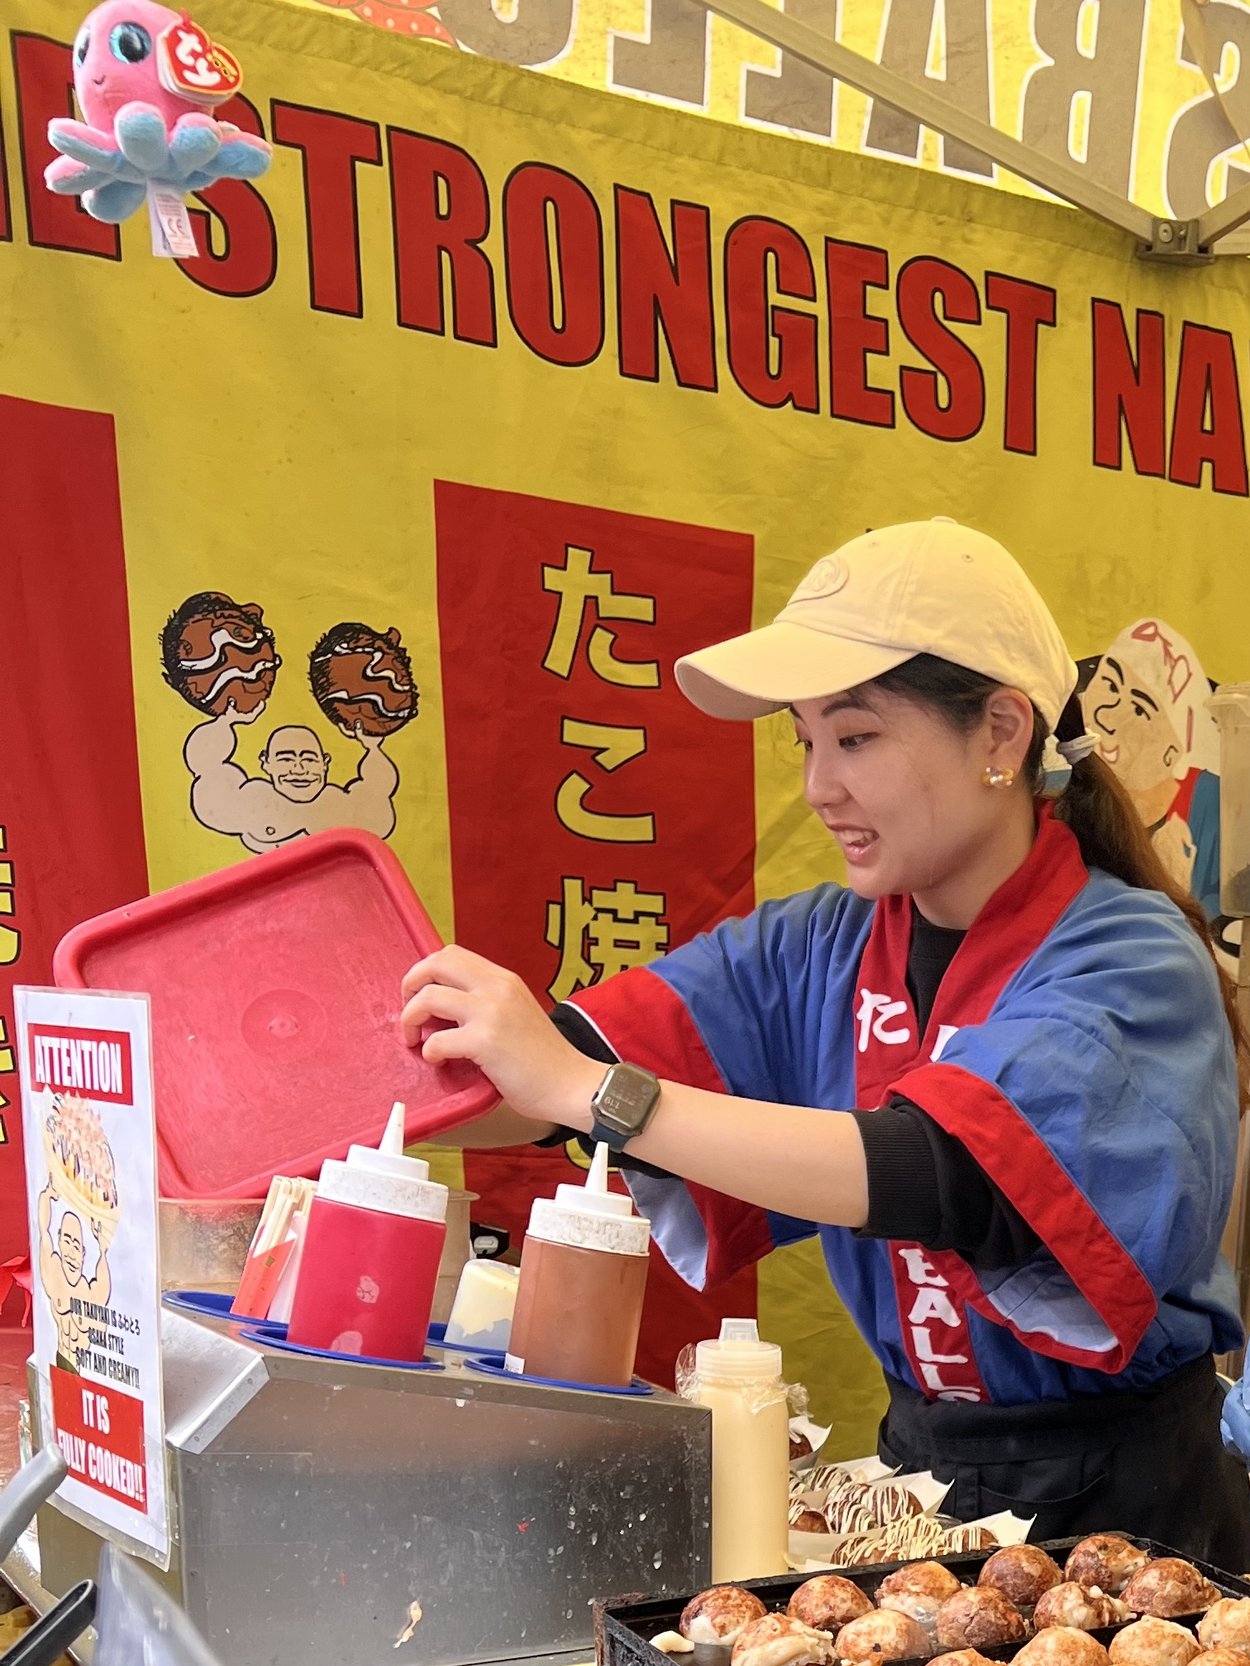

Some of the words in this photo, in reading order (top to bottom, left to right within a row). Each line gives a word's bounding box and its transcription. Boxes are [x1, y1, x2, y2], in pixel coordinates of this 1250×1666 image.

[171, 91, 1056, 456] STRONGEST
[541, 544, 670, 1172] たこ焼
[33, 1035, 123, 1094] ATTENTION
[94, 1352, 107, 1376] AND
[108, 1333, 124, 1355] STYLE
[82, 1389, 95, 1428] IT
[96, 1394, 110, 1434] IS
[88, 1442, 145, 1503] COOKED!!
